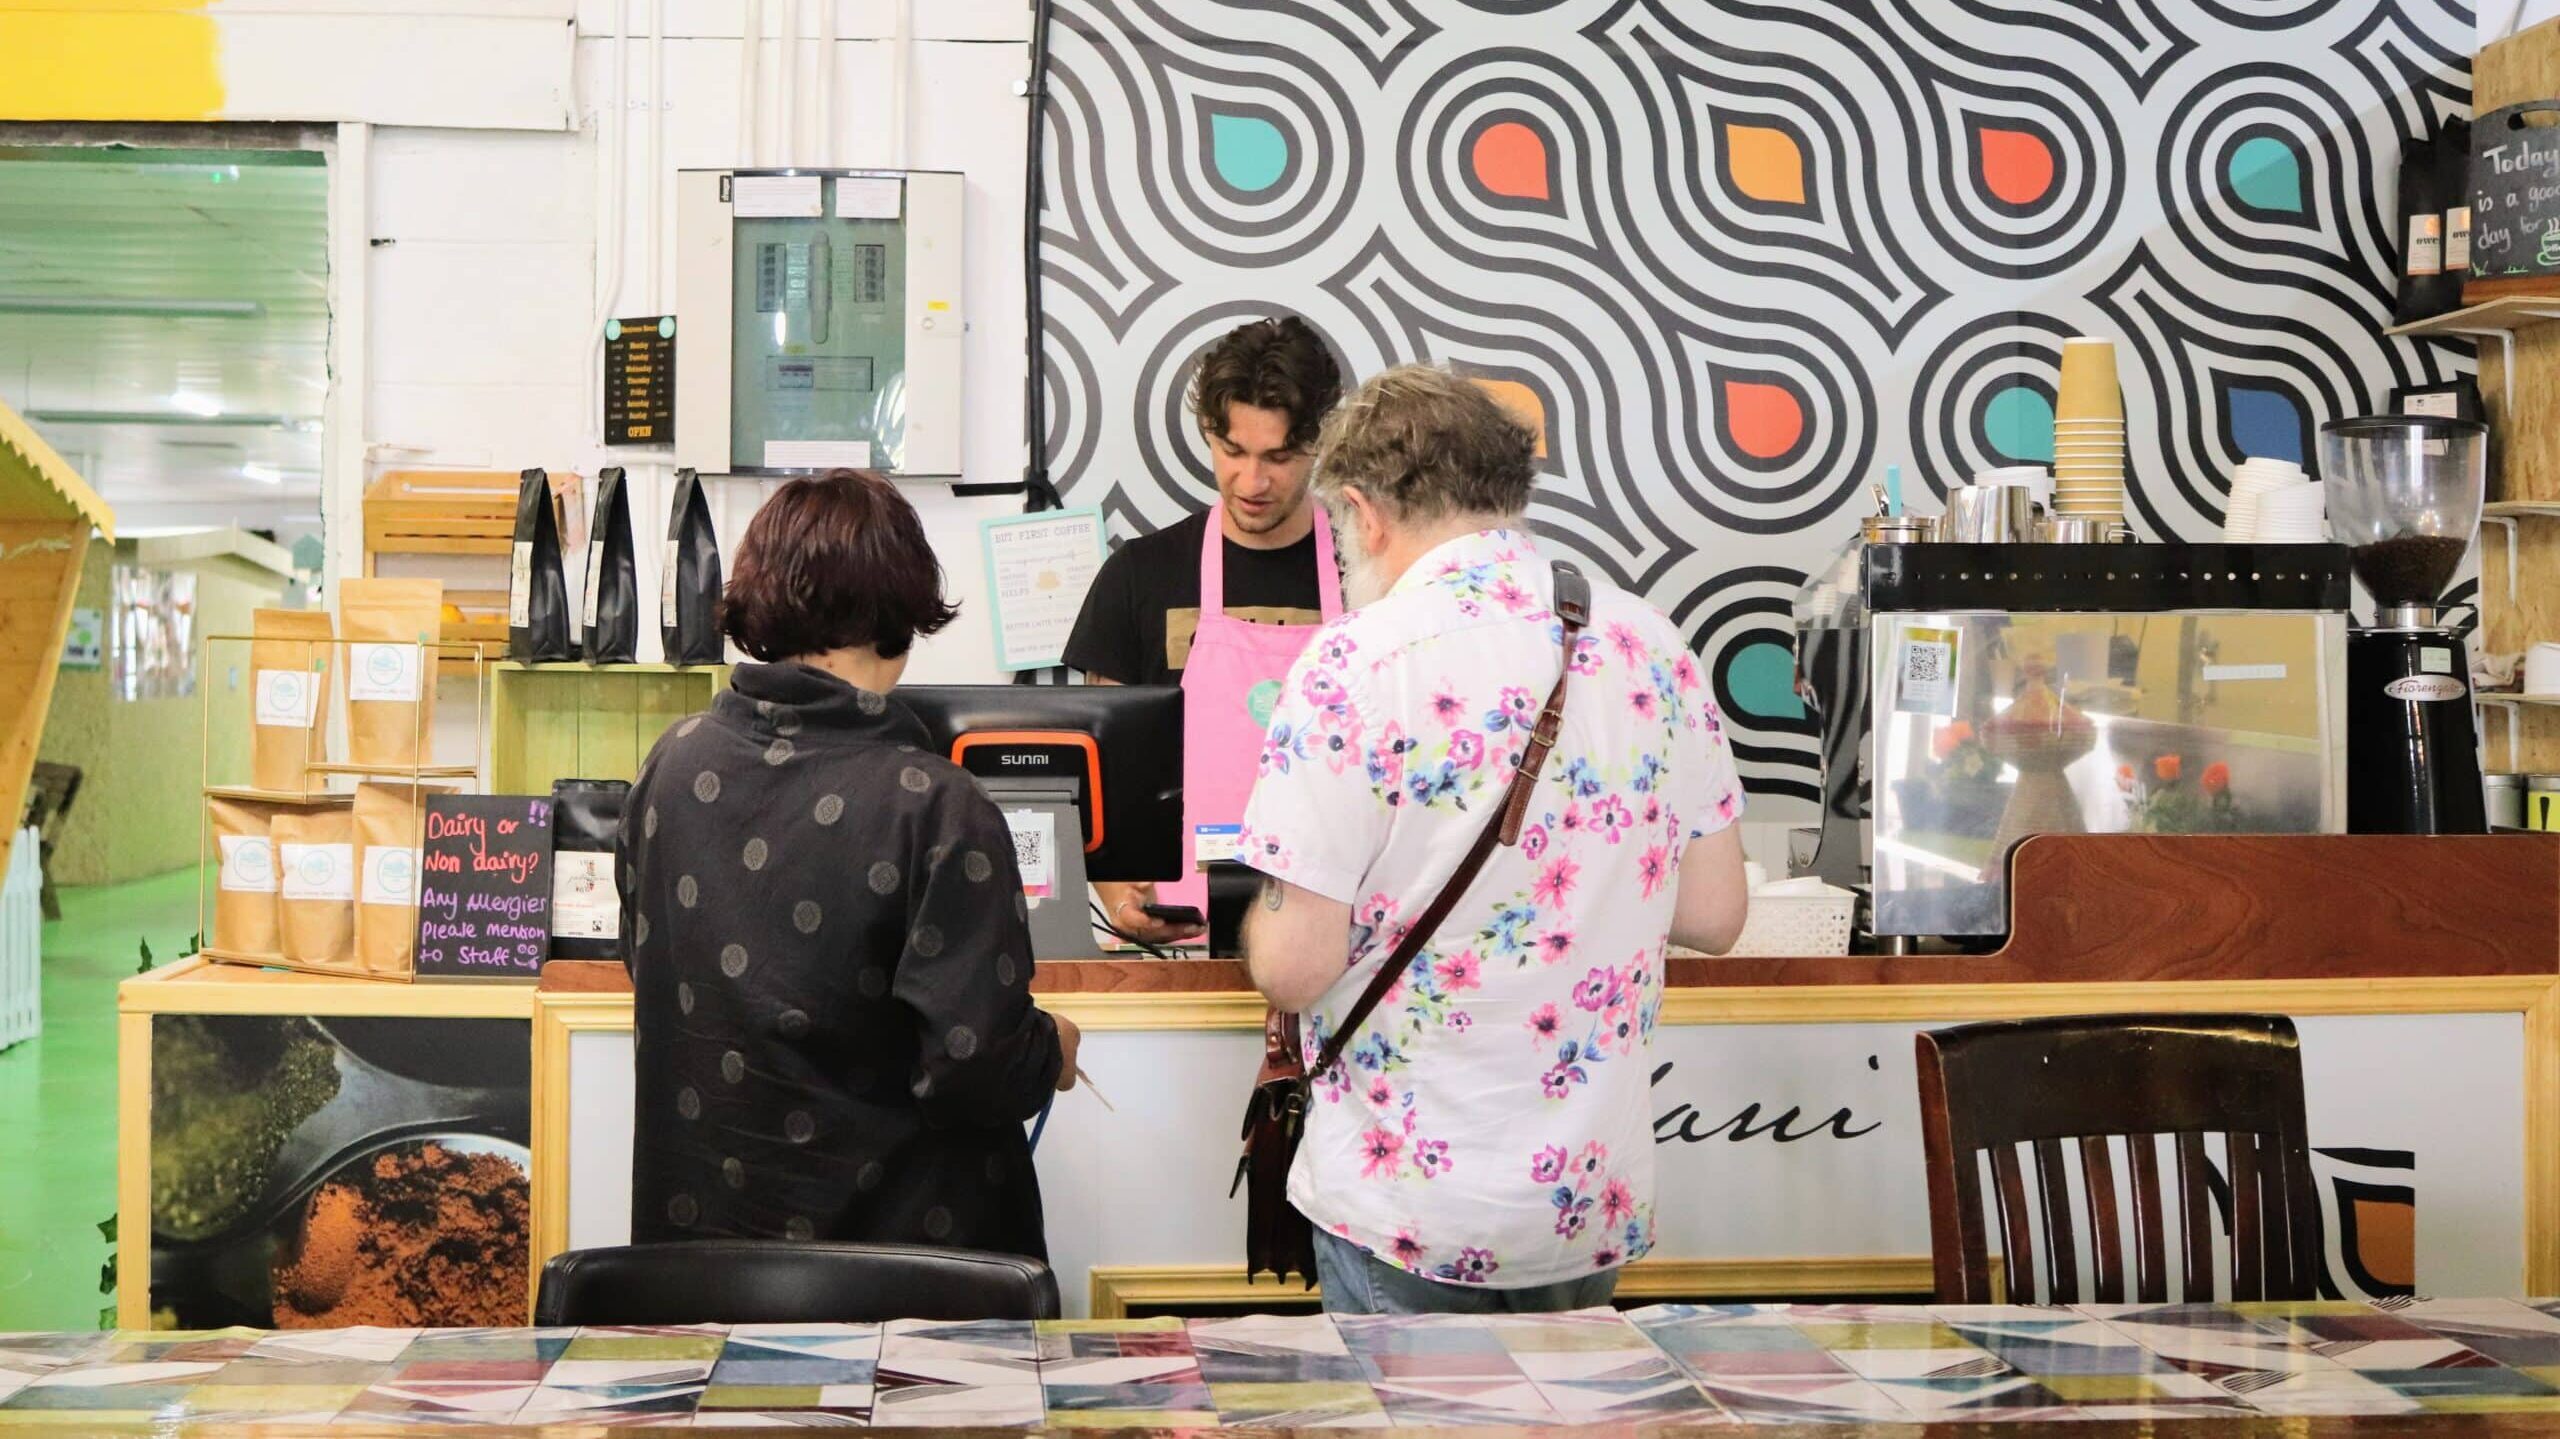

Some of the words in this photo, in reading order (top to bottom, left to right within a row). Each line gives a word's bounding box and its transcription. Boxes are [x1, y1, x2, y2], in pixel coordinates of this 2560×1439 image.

[2482, 141, 2560, 178] Today
[2477, 190, 2494, 213] is
[2506, 192, 2519, 208] a
[2477, 222, 2512, 252] day
[2520, 215, 2543, 236] for
[627, 425, 652, 438] OPEN
[1019, 528, 1048, 541] FIRST
[1054, 523, 1091, 537] COFFEE
[428, 812, 486, 855] Dairy
[497, 817, 520, 834] or
[424, 850, 461, 873] Non
[472, 851, 539, 884] dairy?
[423, 887, 458, 920] Any
[420, 949, 443, 963] to
[458, 946, 510, 965] Staff
